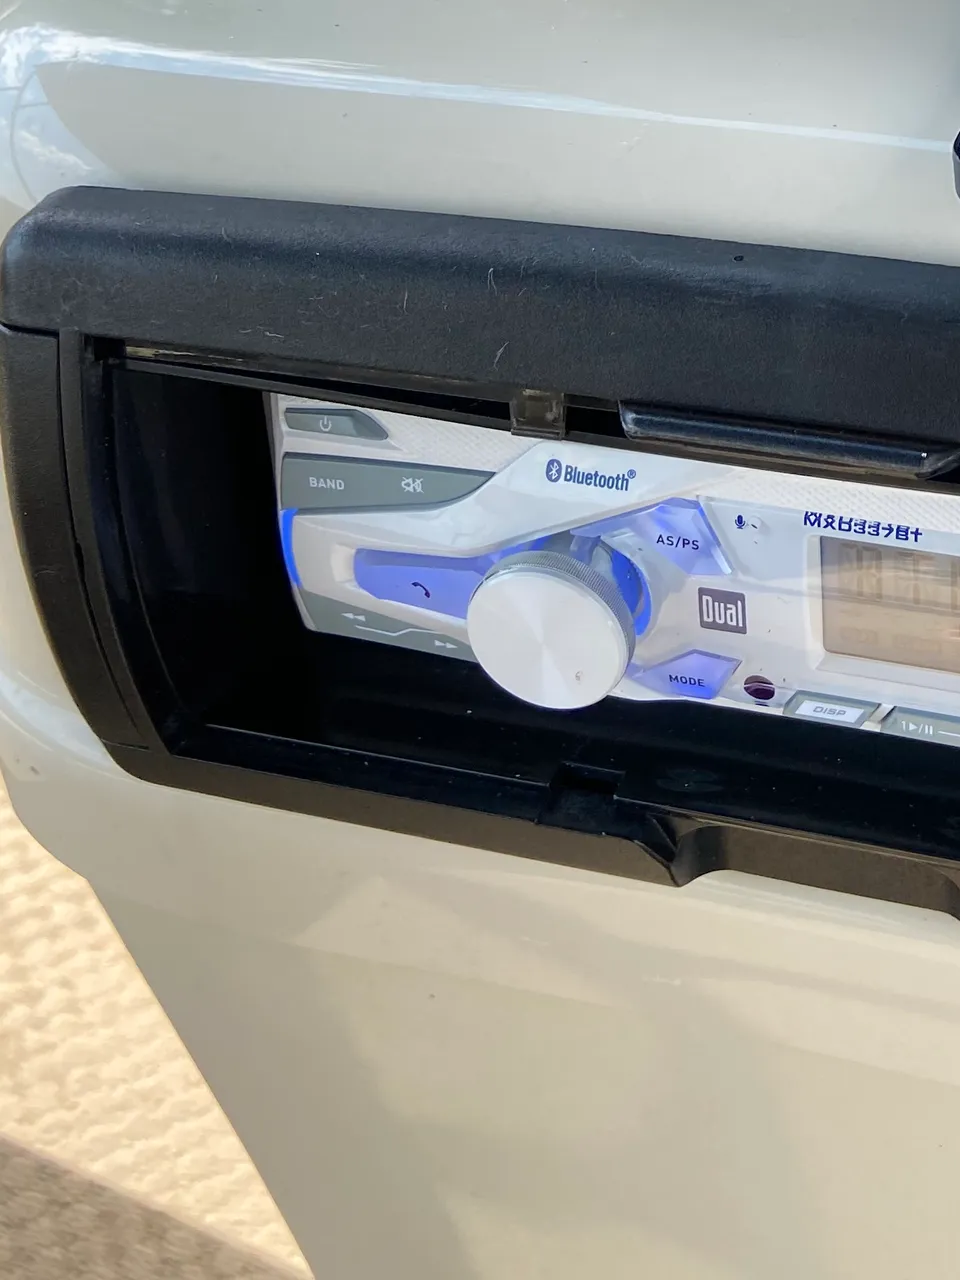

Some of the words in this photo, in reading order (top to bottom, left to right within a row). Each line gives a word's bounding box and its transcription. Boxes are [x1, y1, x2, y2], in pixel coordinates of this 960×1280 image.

[308, 476, 345, 492] BAND
[656, 533, 701, 551] AS/PS
[702, 595, 743, 627] Dual
[668, 673, 705, 688] MODE
[812, 705, 847, 716] DISP
